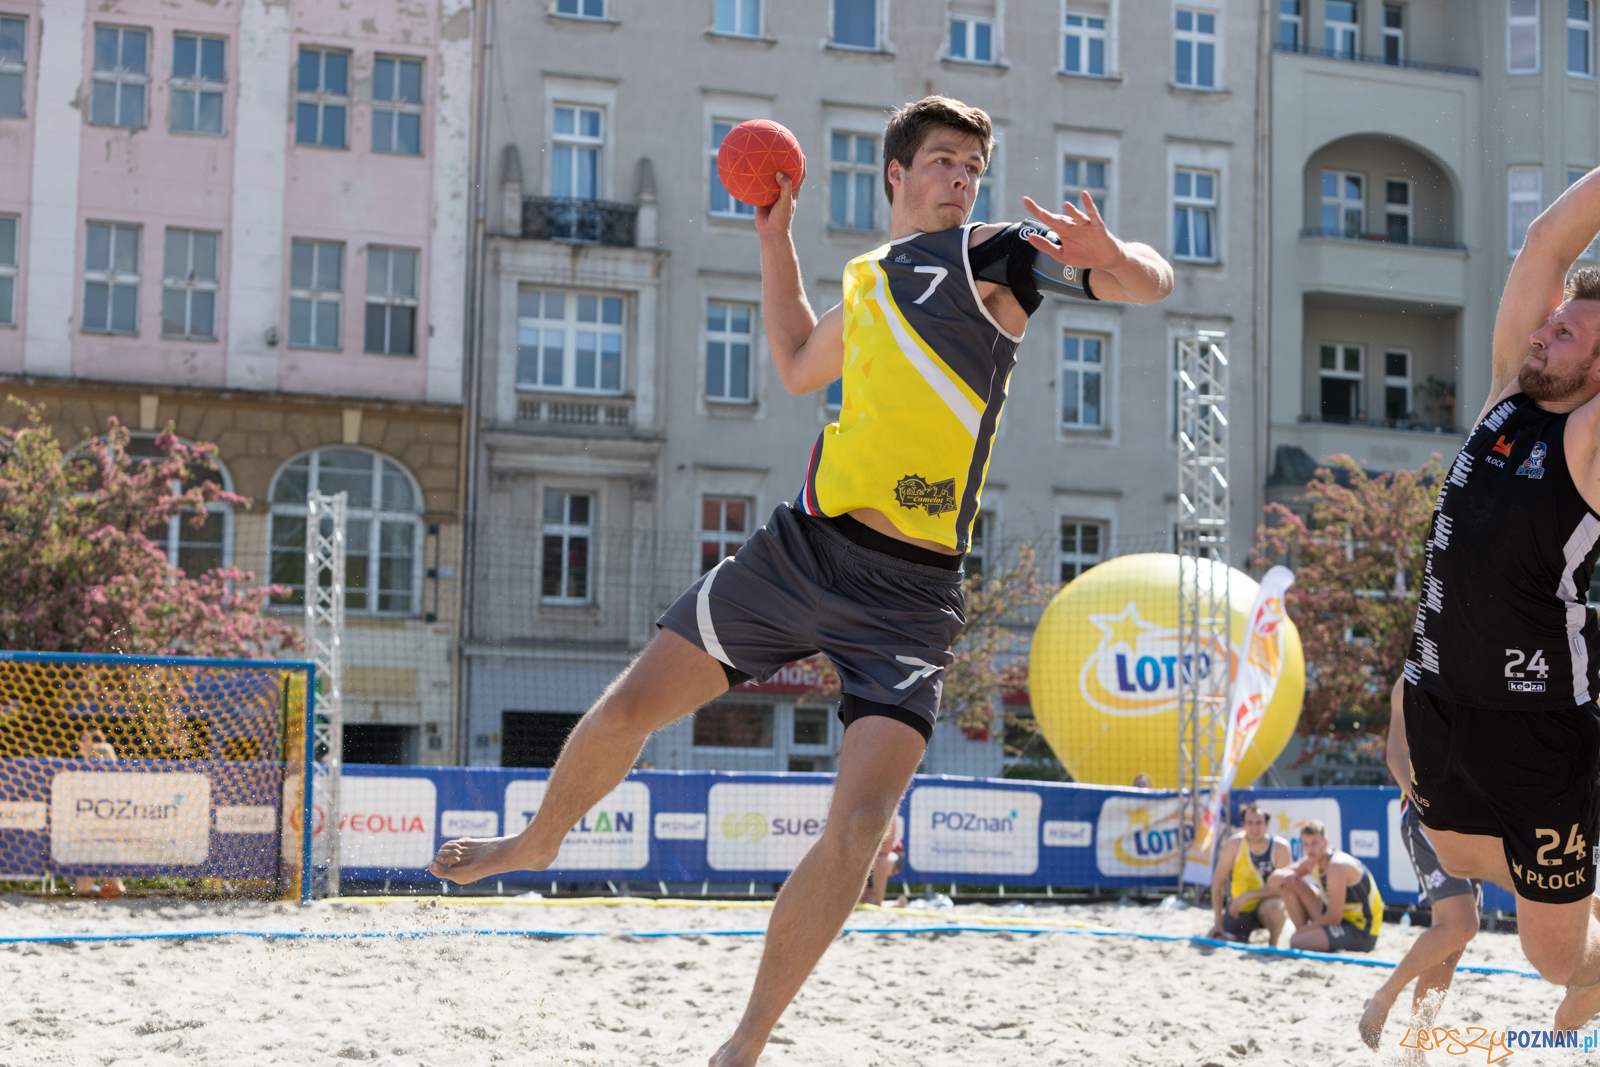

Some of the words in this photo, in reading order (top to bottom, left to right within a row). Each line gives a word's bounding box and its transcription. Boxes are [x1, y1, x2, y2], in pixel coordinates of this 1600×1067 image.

[912, 265, 949, 304] 7
[913, 496, 944, 504] Camelot
[1115, 653, 1212, 693] LOTTO
[1504, 648, 1549, 678] 24
[522, 811, 634, 833] TLAN
[1535, 823, 1586, 866] 24
[1526, 866, 1586, 890] PŁOCK
